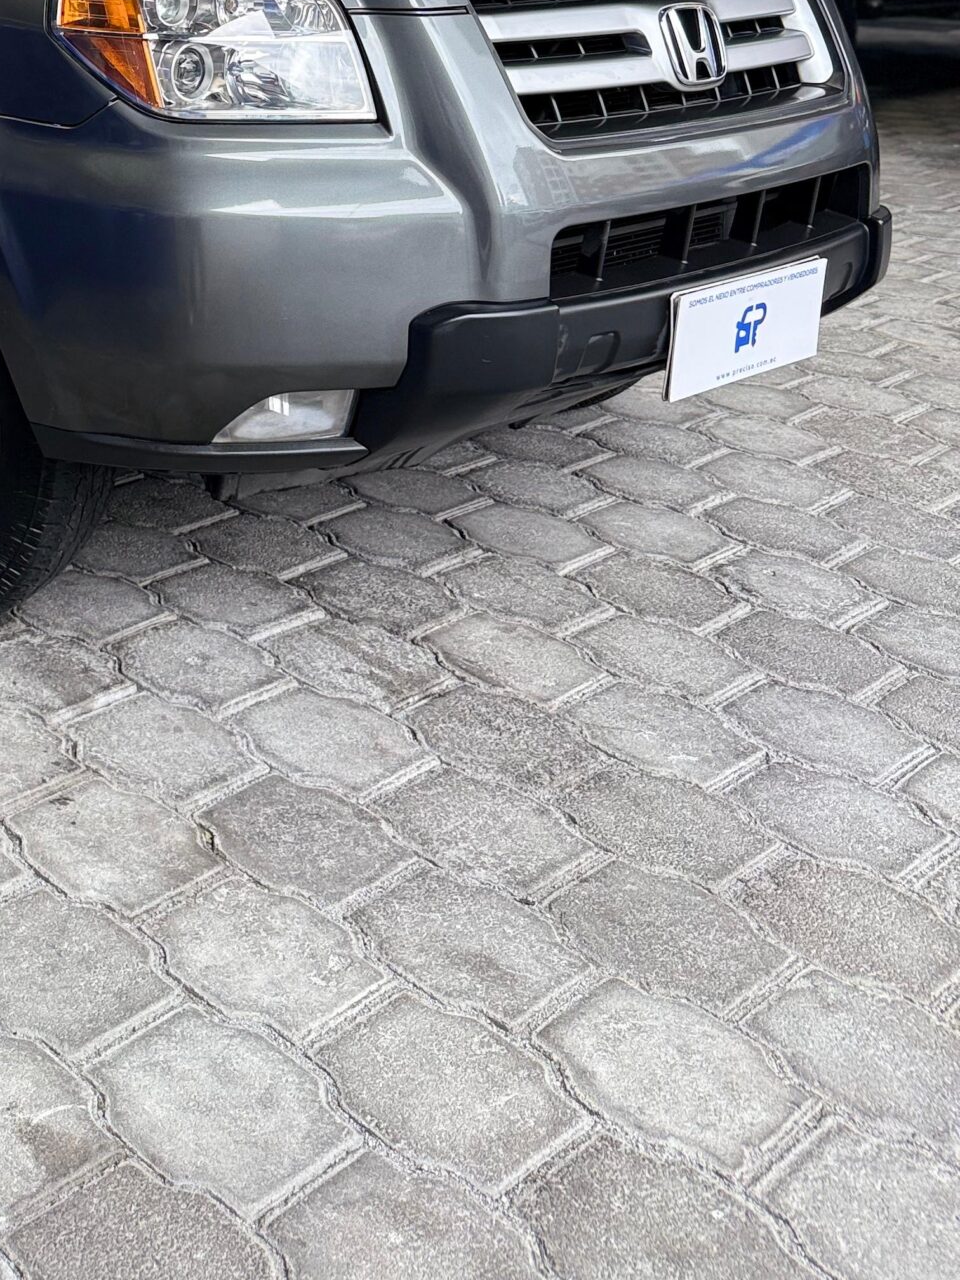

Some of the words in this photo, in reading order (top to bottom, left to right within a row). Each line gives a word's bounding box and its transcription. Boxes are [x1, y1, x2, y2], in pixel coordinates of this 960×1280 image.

[689, 296, 708, 308] SOMOS
[708, 295, 715, 303] EL
[715, 290, 730, 301] NEXO
[730, 287, 746, 297] ENTRE
[746, 277, 784, 293] COMPRADORES
[788, 267, 818, 281] VENDEDORES
